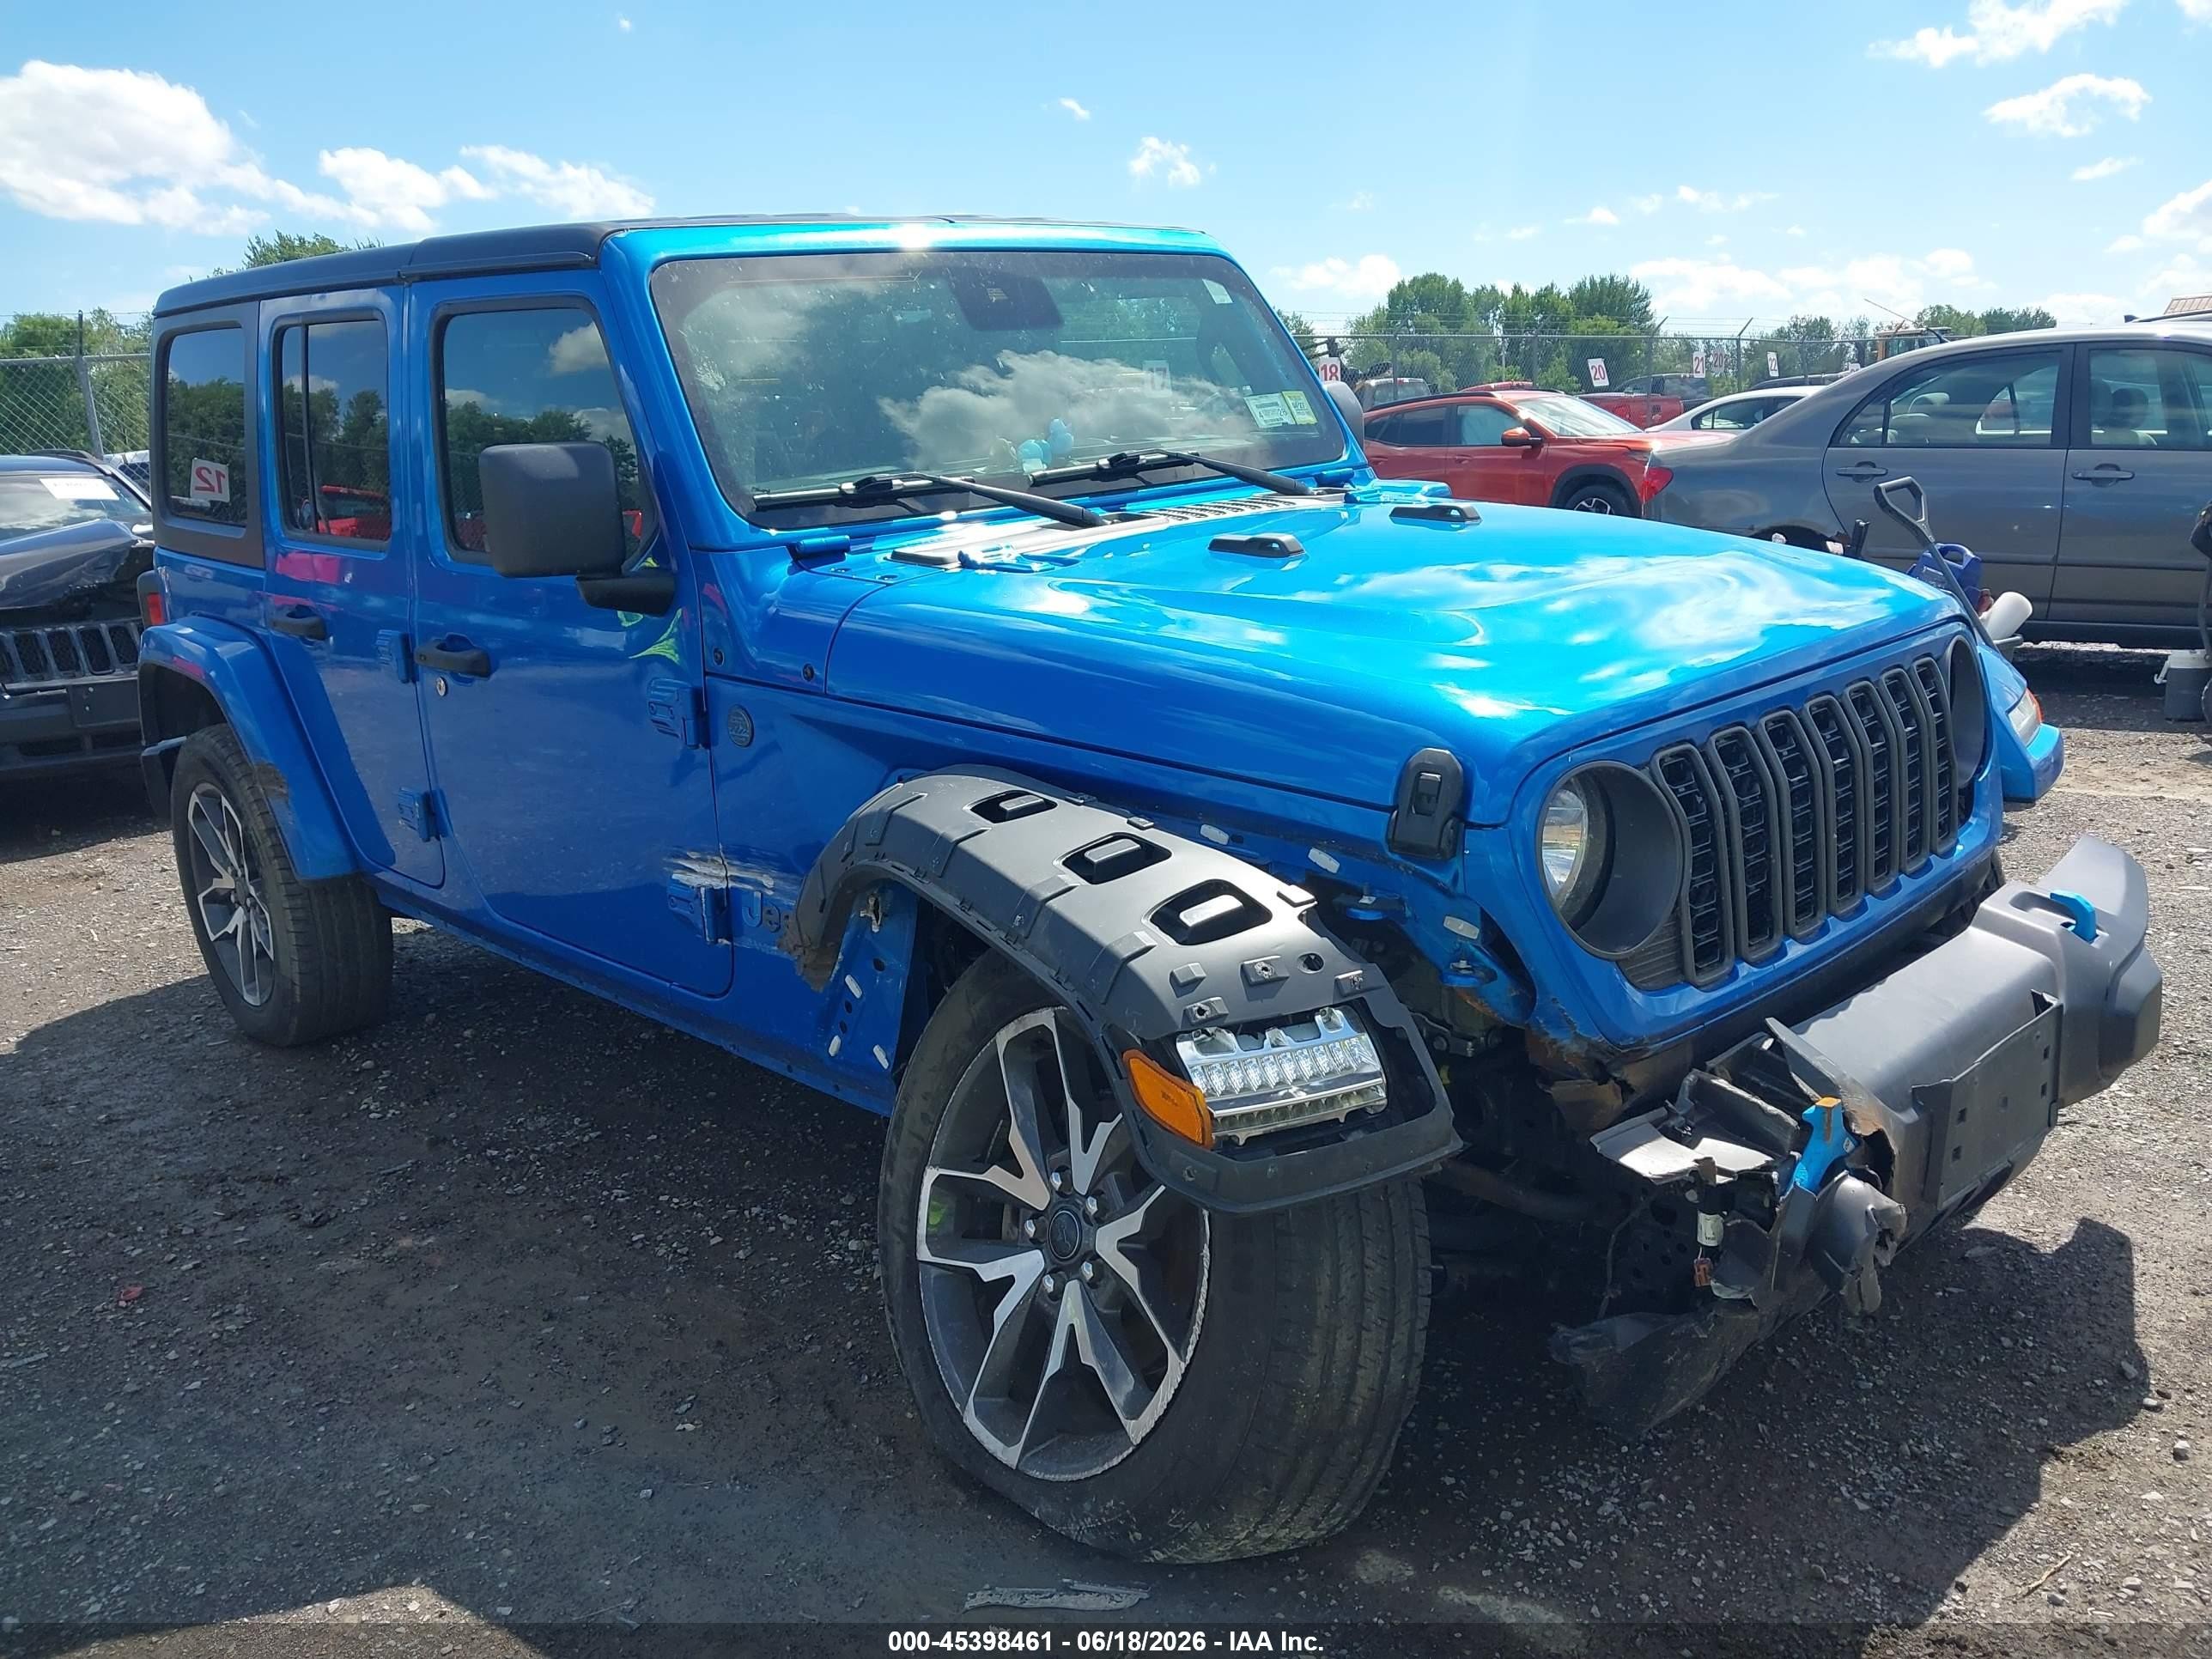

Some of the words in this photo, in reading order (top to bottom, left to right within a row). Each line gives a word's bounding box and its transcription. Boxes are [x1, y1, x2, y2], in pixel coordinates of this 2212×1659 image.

[1321, 363, 1340, 381] 18
[1694, 356, 1705, 374] 21
[1769, 357, 1778, 371] 22
[1591, 365, 1606, 380] 20
